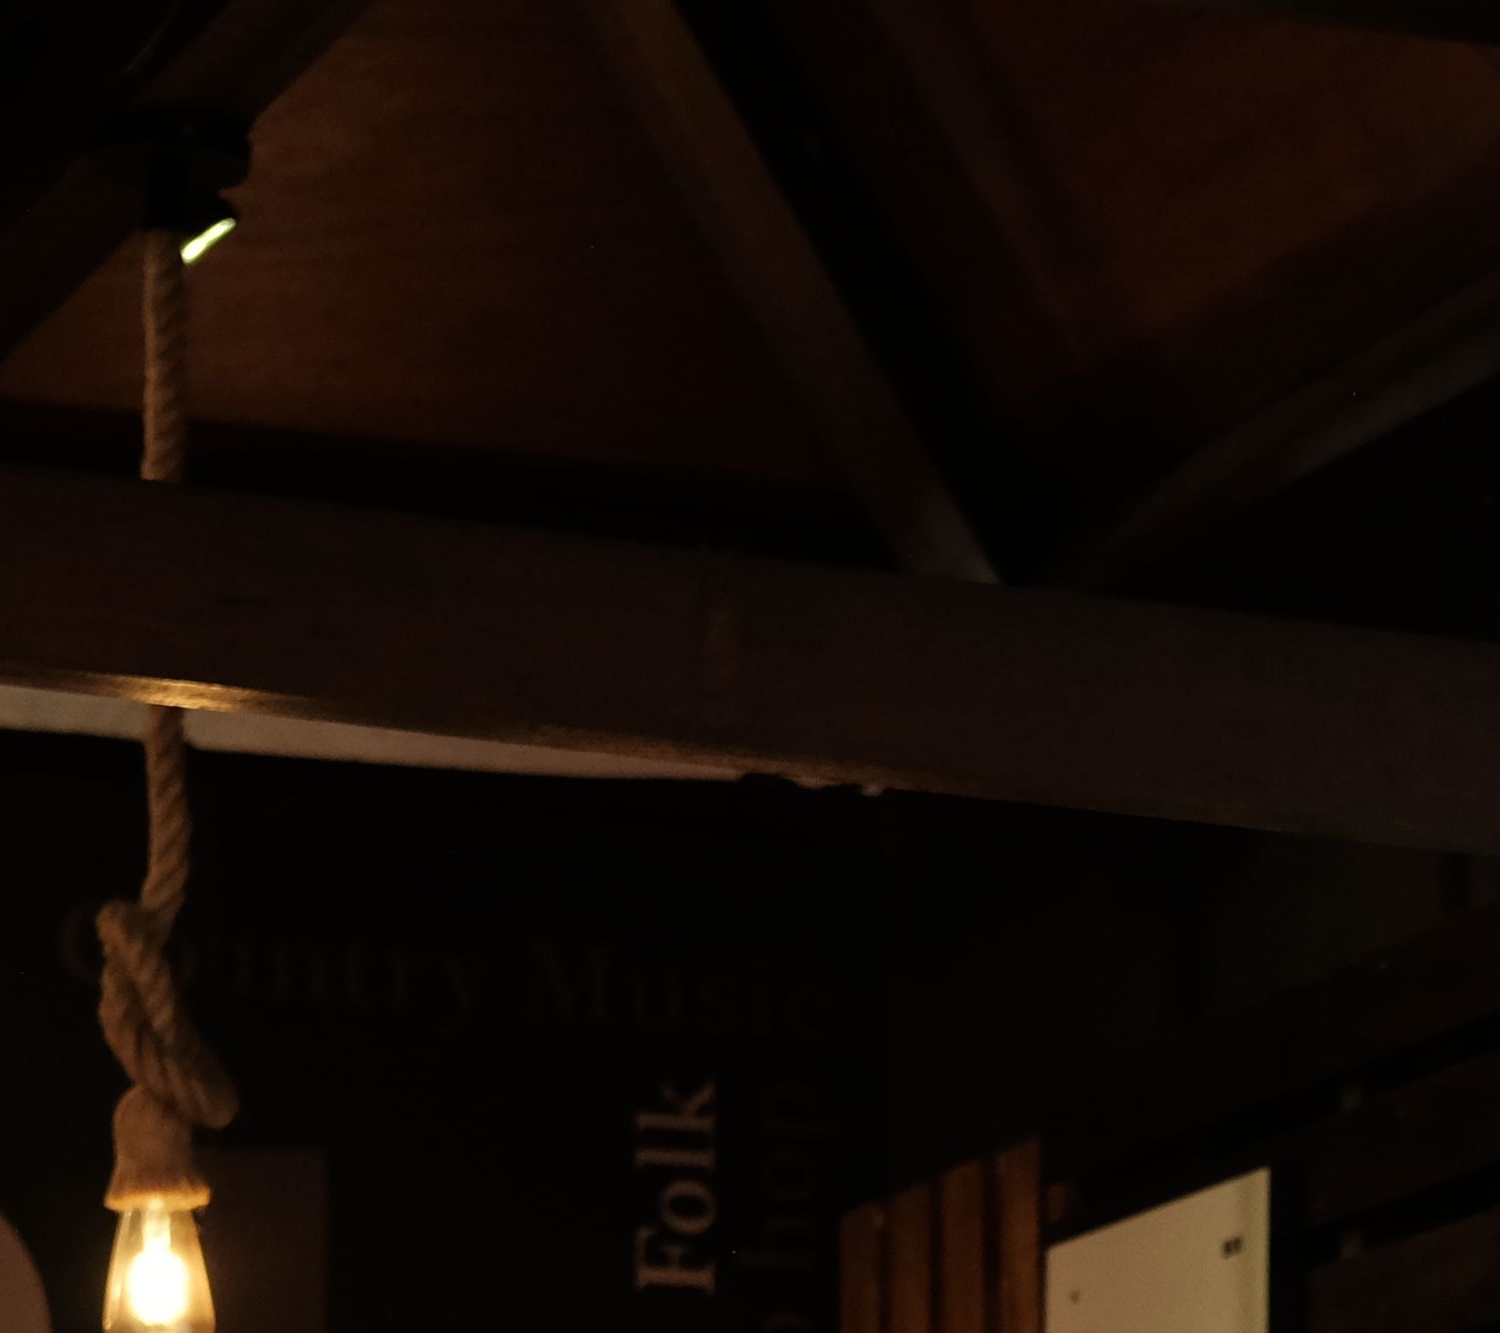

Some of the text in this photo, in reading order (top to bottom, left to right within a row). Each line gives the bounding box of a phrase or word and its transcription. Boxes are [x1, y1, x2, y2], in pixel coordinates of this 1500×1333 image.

[522, 936, 838, 1042] Music
[630, 1073, 718, 1296] Folk
[734, 1077, 843, 1282] hop
